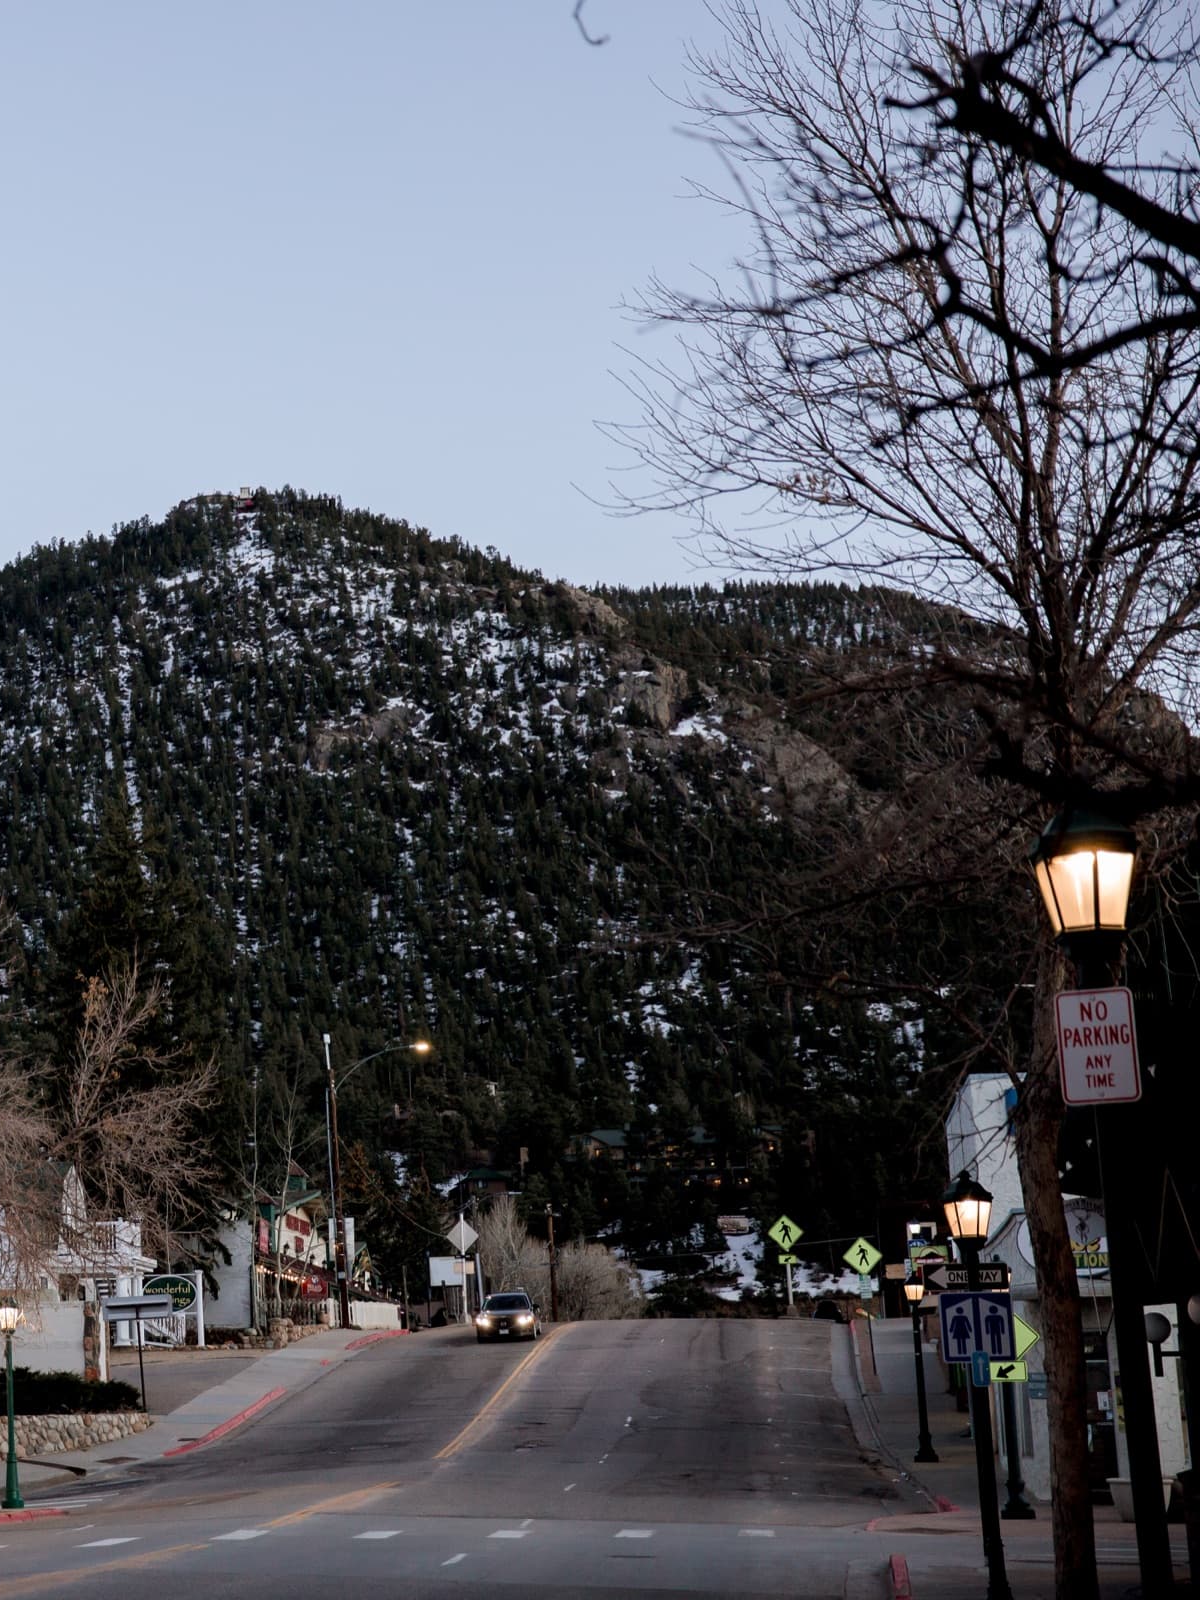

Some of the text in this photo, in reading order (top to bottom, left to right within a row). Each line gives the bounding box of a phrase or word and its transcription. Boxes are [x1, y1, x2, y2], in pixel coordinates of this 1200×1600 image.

[1079, 1000, 1108, 1022] NO
[1063, 1023, 1130, 1048] PARKING
[1085, 1054, 1112, 1069] ANY
[1085, 1073, 1116, 1088] TIME
[144, 1281, 191, 1294] wonderful
